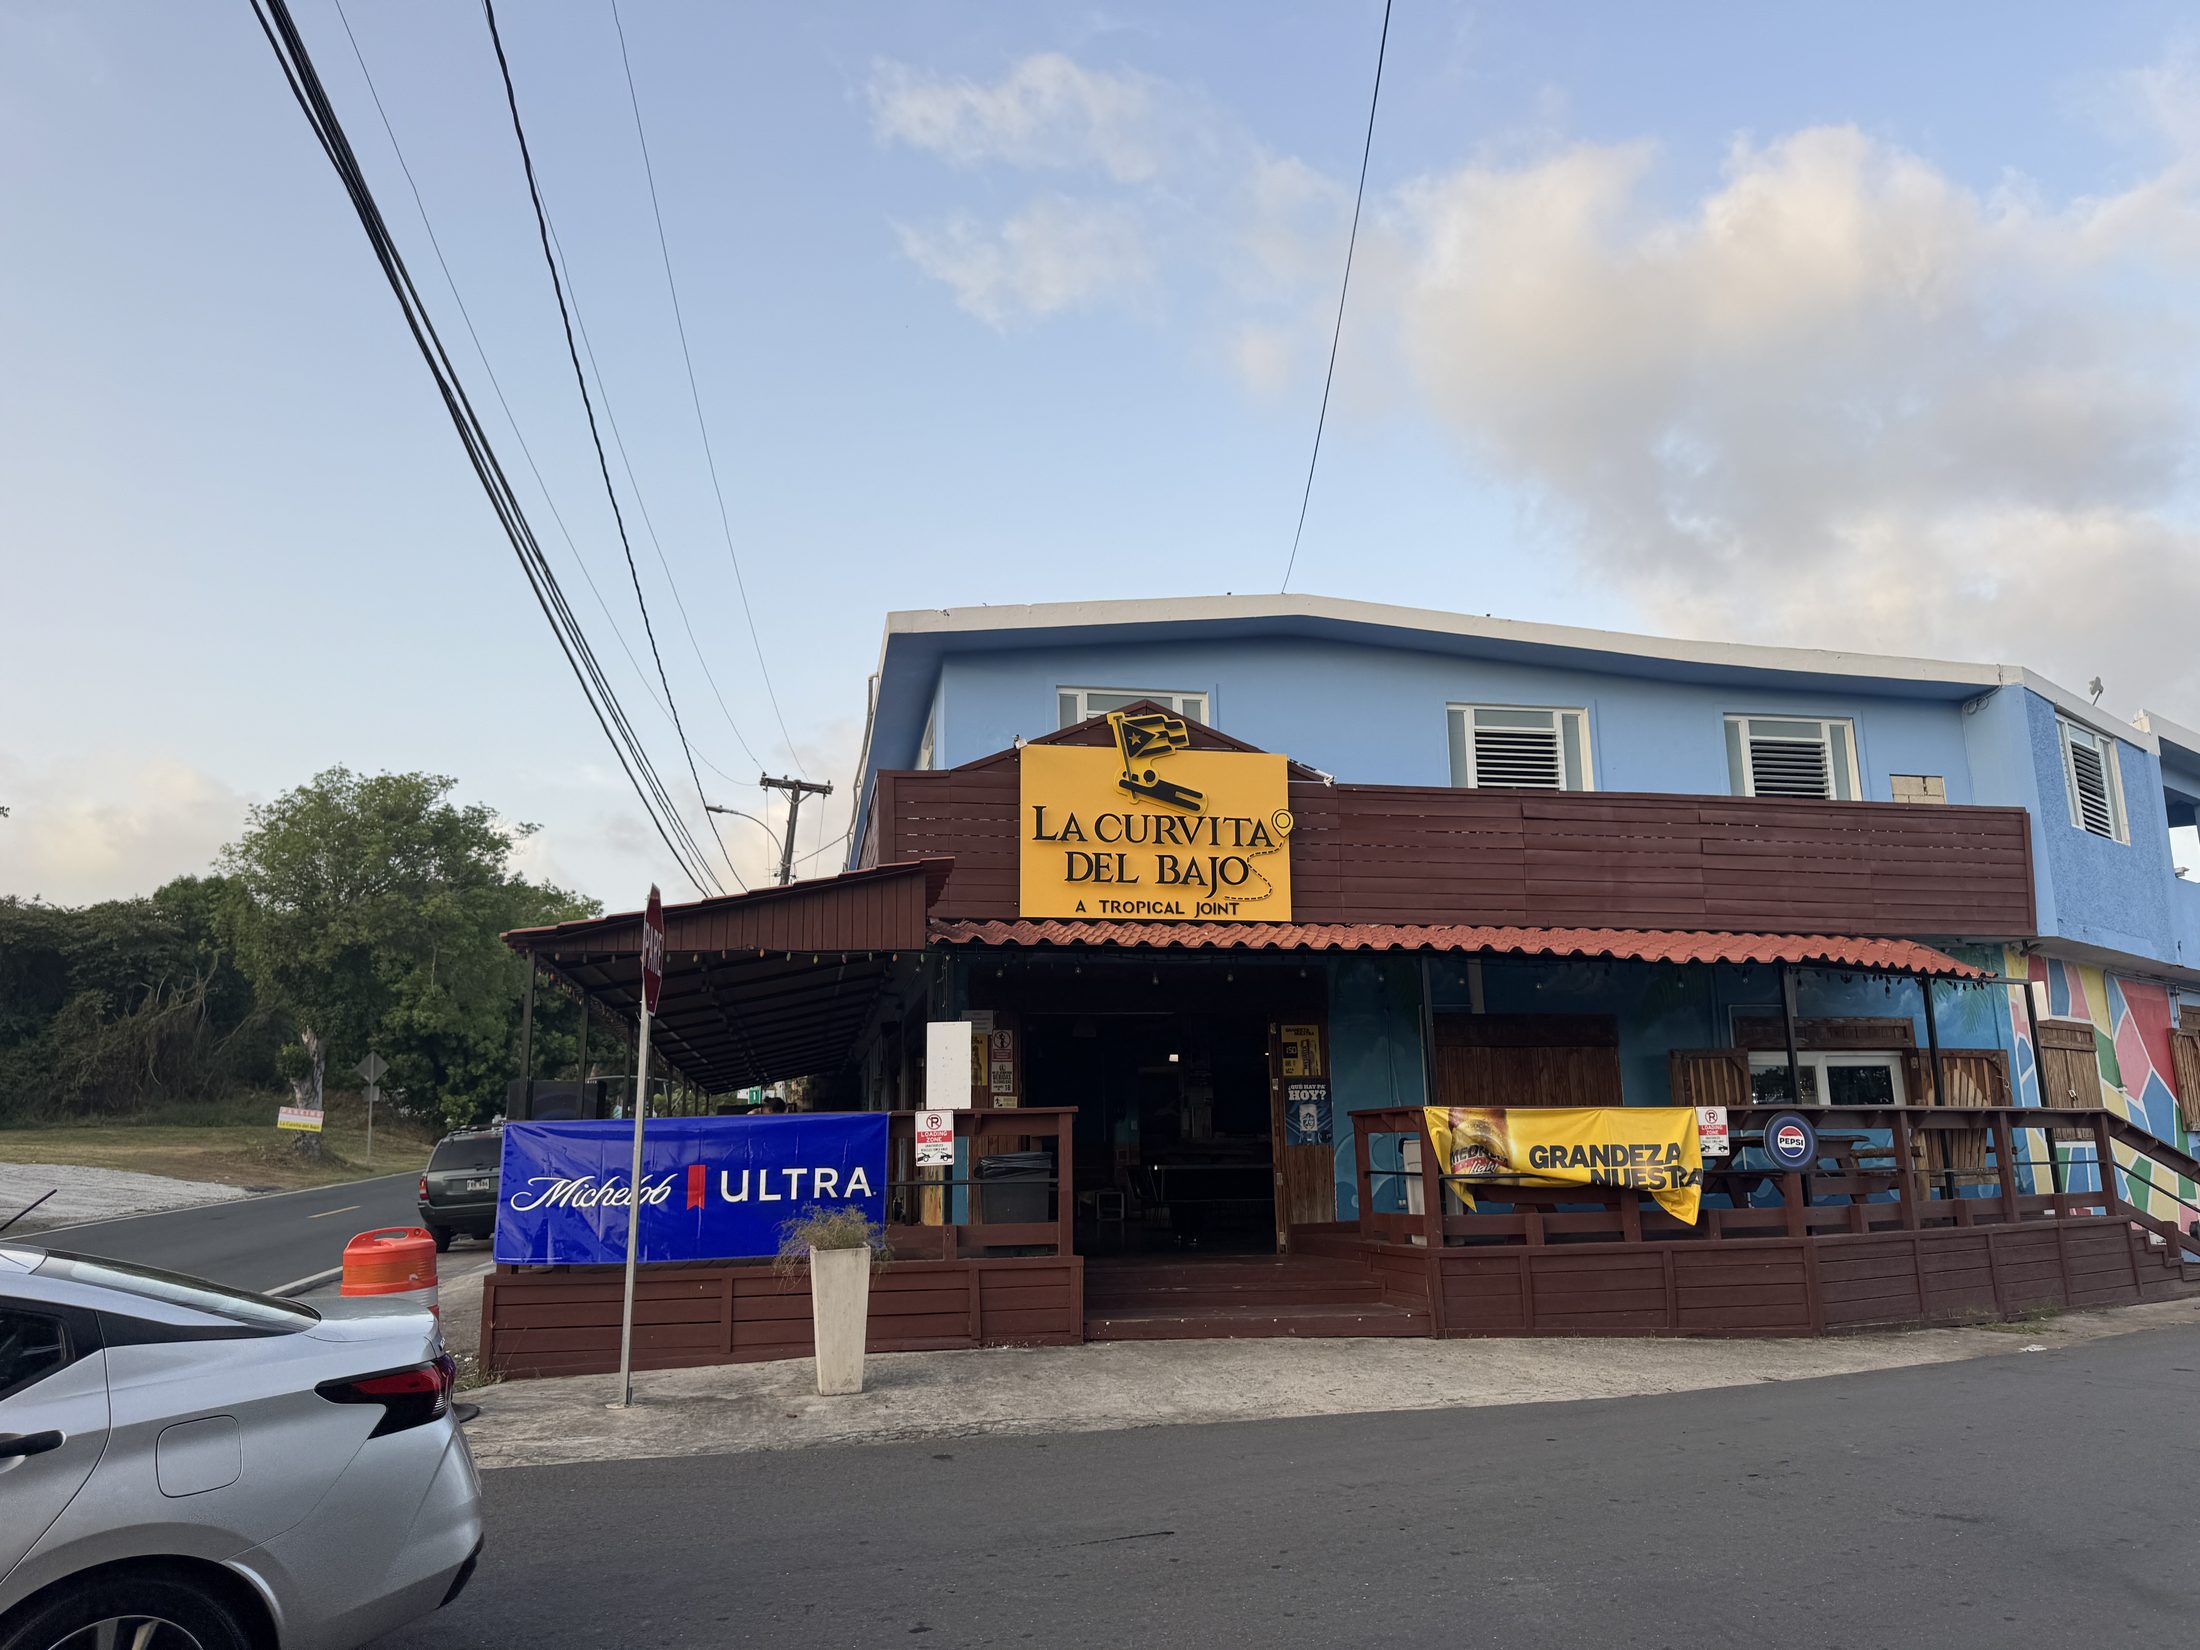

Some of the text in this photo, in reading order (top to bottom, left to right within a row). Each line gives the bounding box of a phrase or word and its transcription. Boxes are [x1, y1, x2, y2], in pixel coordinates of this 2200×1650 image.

[1094, 813, 1275, 848] CURVITA
[1065, 851, 1249, 898] DEL BAJO
[1075, 900, 1239, 918] A TROPICAL JOINT
[1288, 1090, 1327, 1101] HOY?
[920, 1130, 947, 1138] LOADING
[1780, 1138, 1803, 1146] PEPSI
[1529, 1143, 1681, 1169] GRANDEZA
[721, 1167, 873, 1203] ULTRA
